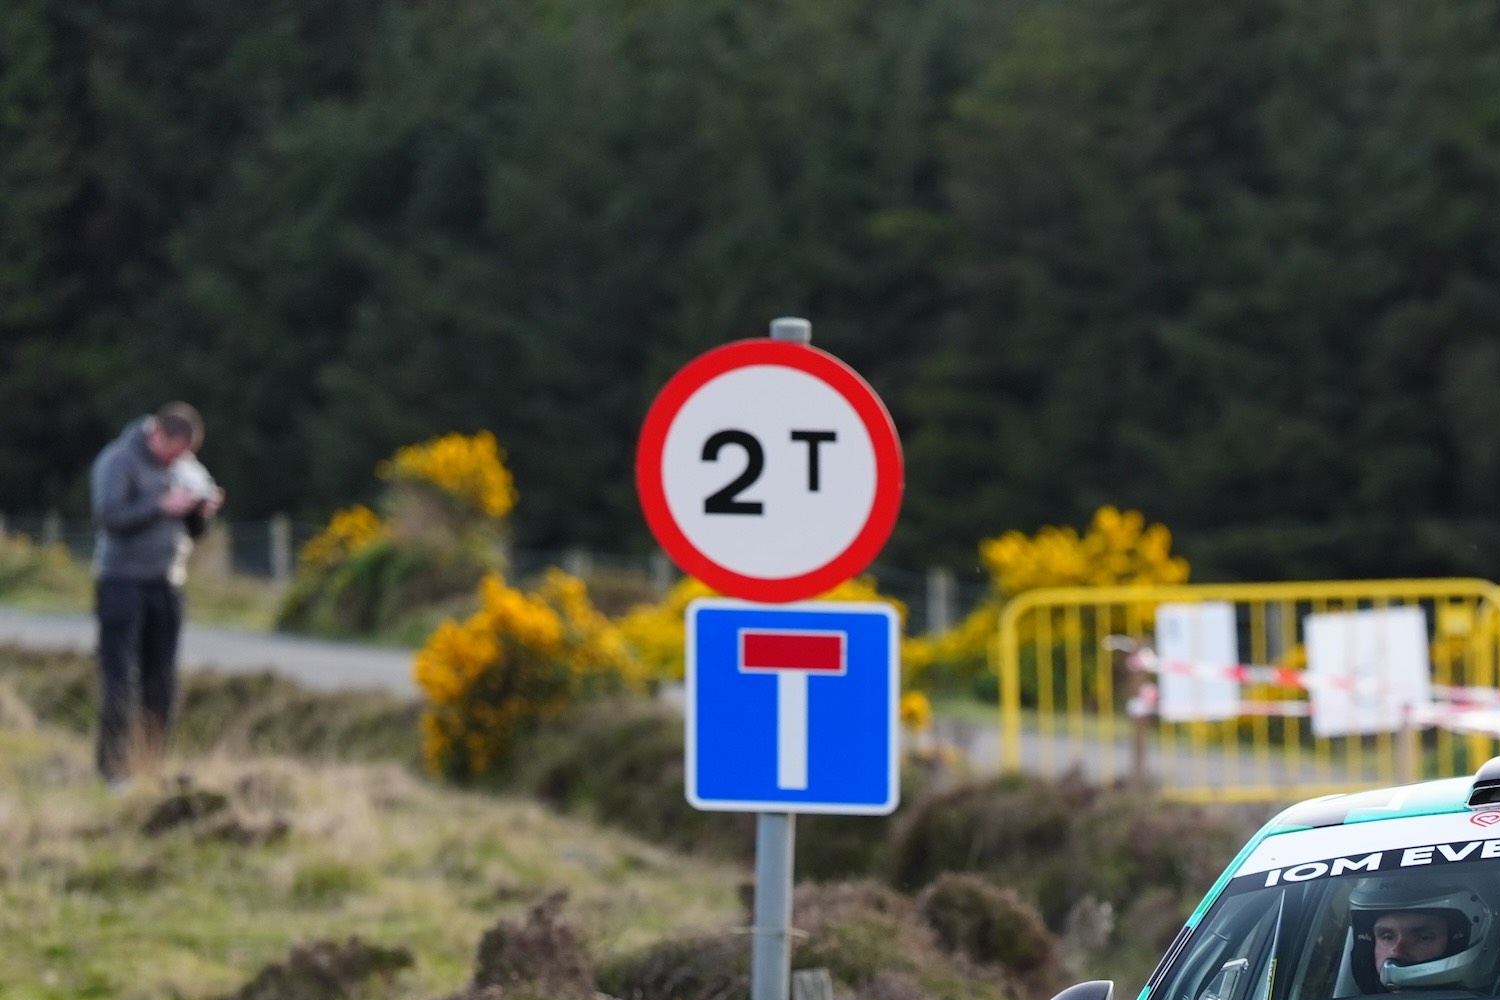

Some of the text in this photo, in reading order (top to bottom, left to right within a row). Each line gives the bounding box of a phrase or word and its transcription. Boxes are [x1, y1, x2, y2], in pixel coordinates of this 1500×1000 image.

[701, 429, 838, 516] 2 T
[1264, 852, 1383, 888] IOM
